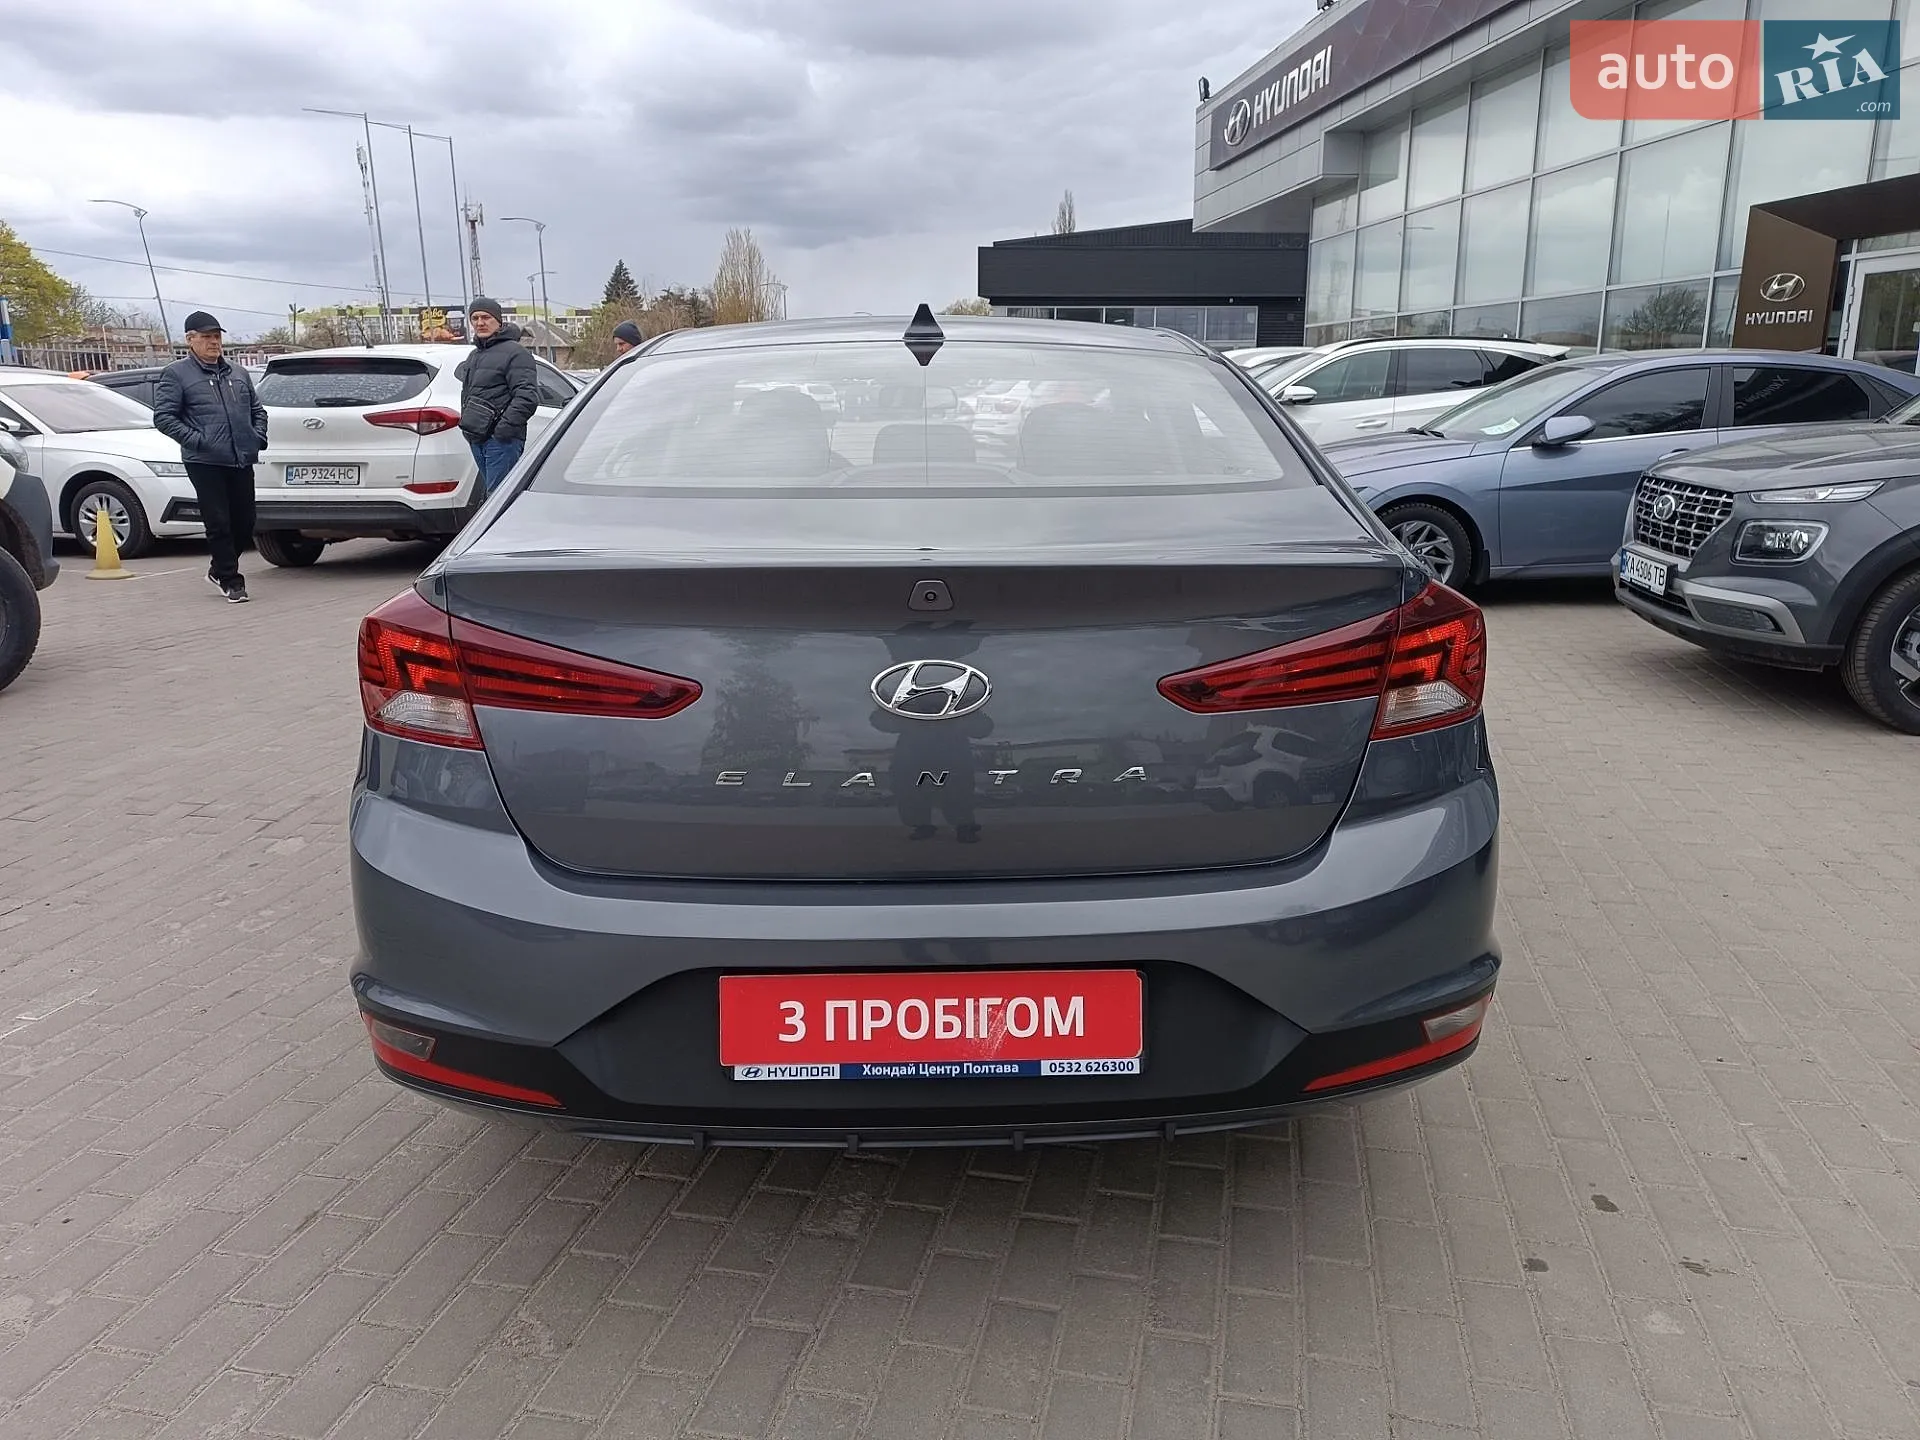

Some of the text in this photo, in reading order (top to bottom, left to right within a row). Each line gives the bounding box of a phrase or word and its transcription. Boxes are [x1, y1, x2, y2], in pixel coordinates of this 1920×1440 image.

[1253, 44, 1332, 129] HYUNDAI
[1745, 310, 1814, 325] HYUNDAI
[311, 469, 336, 480] 9324
[715, 766, 1147, 788] ELANTRA
[825, 996, 1085, 1042] ПРОБІГОМ
[767, 1066, 835, 1078] HYUNDAI
[862, 1062, 1019, 1078] Хюндай Центр Полтава
[1049, 1060, 1135, 1073] 0532 626300
